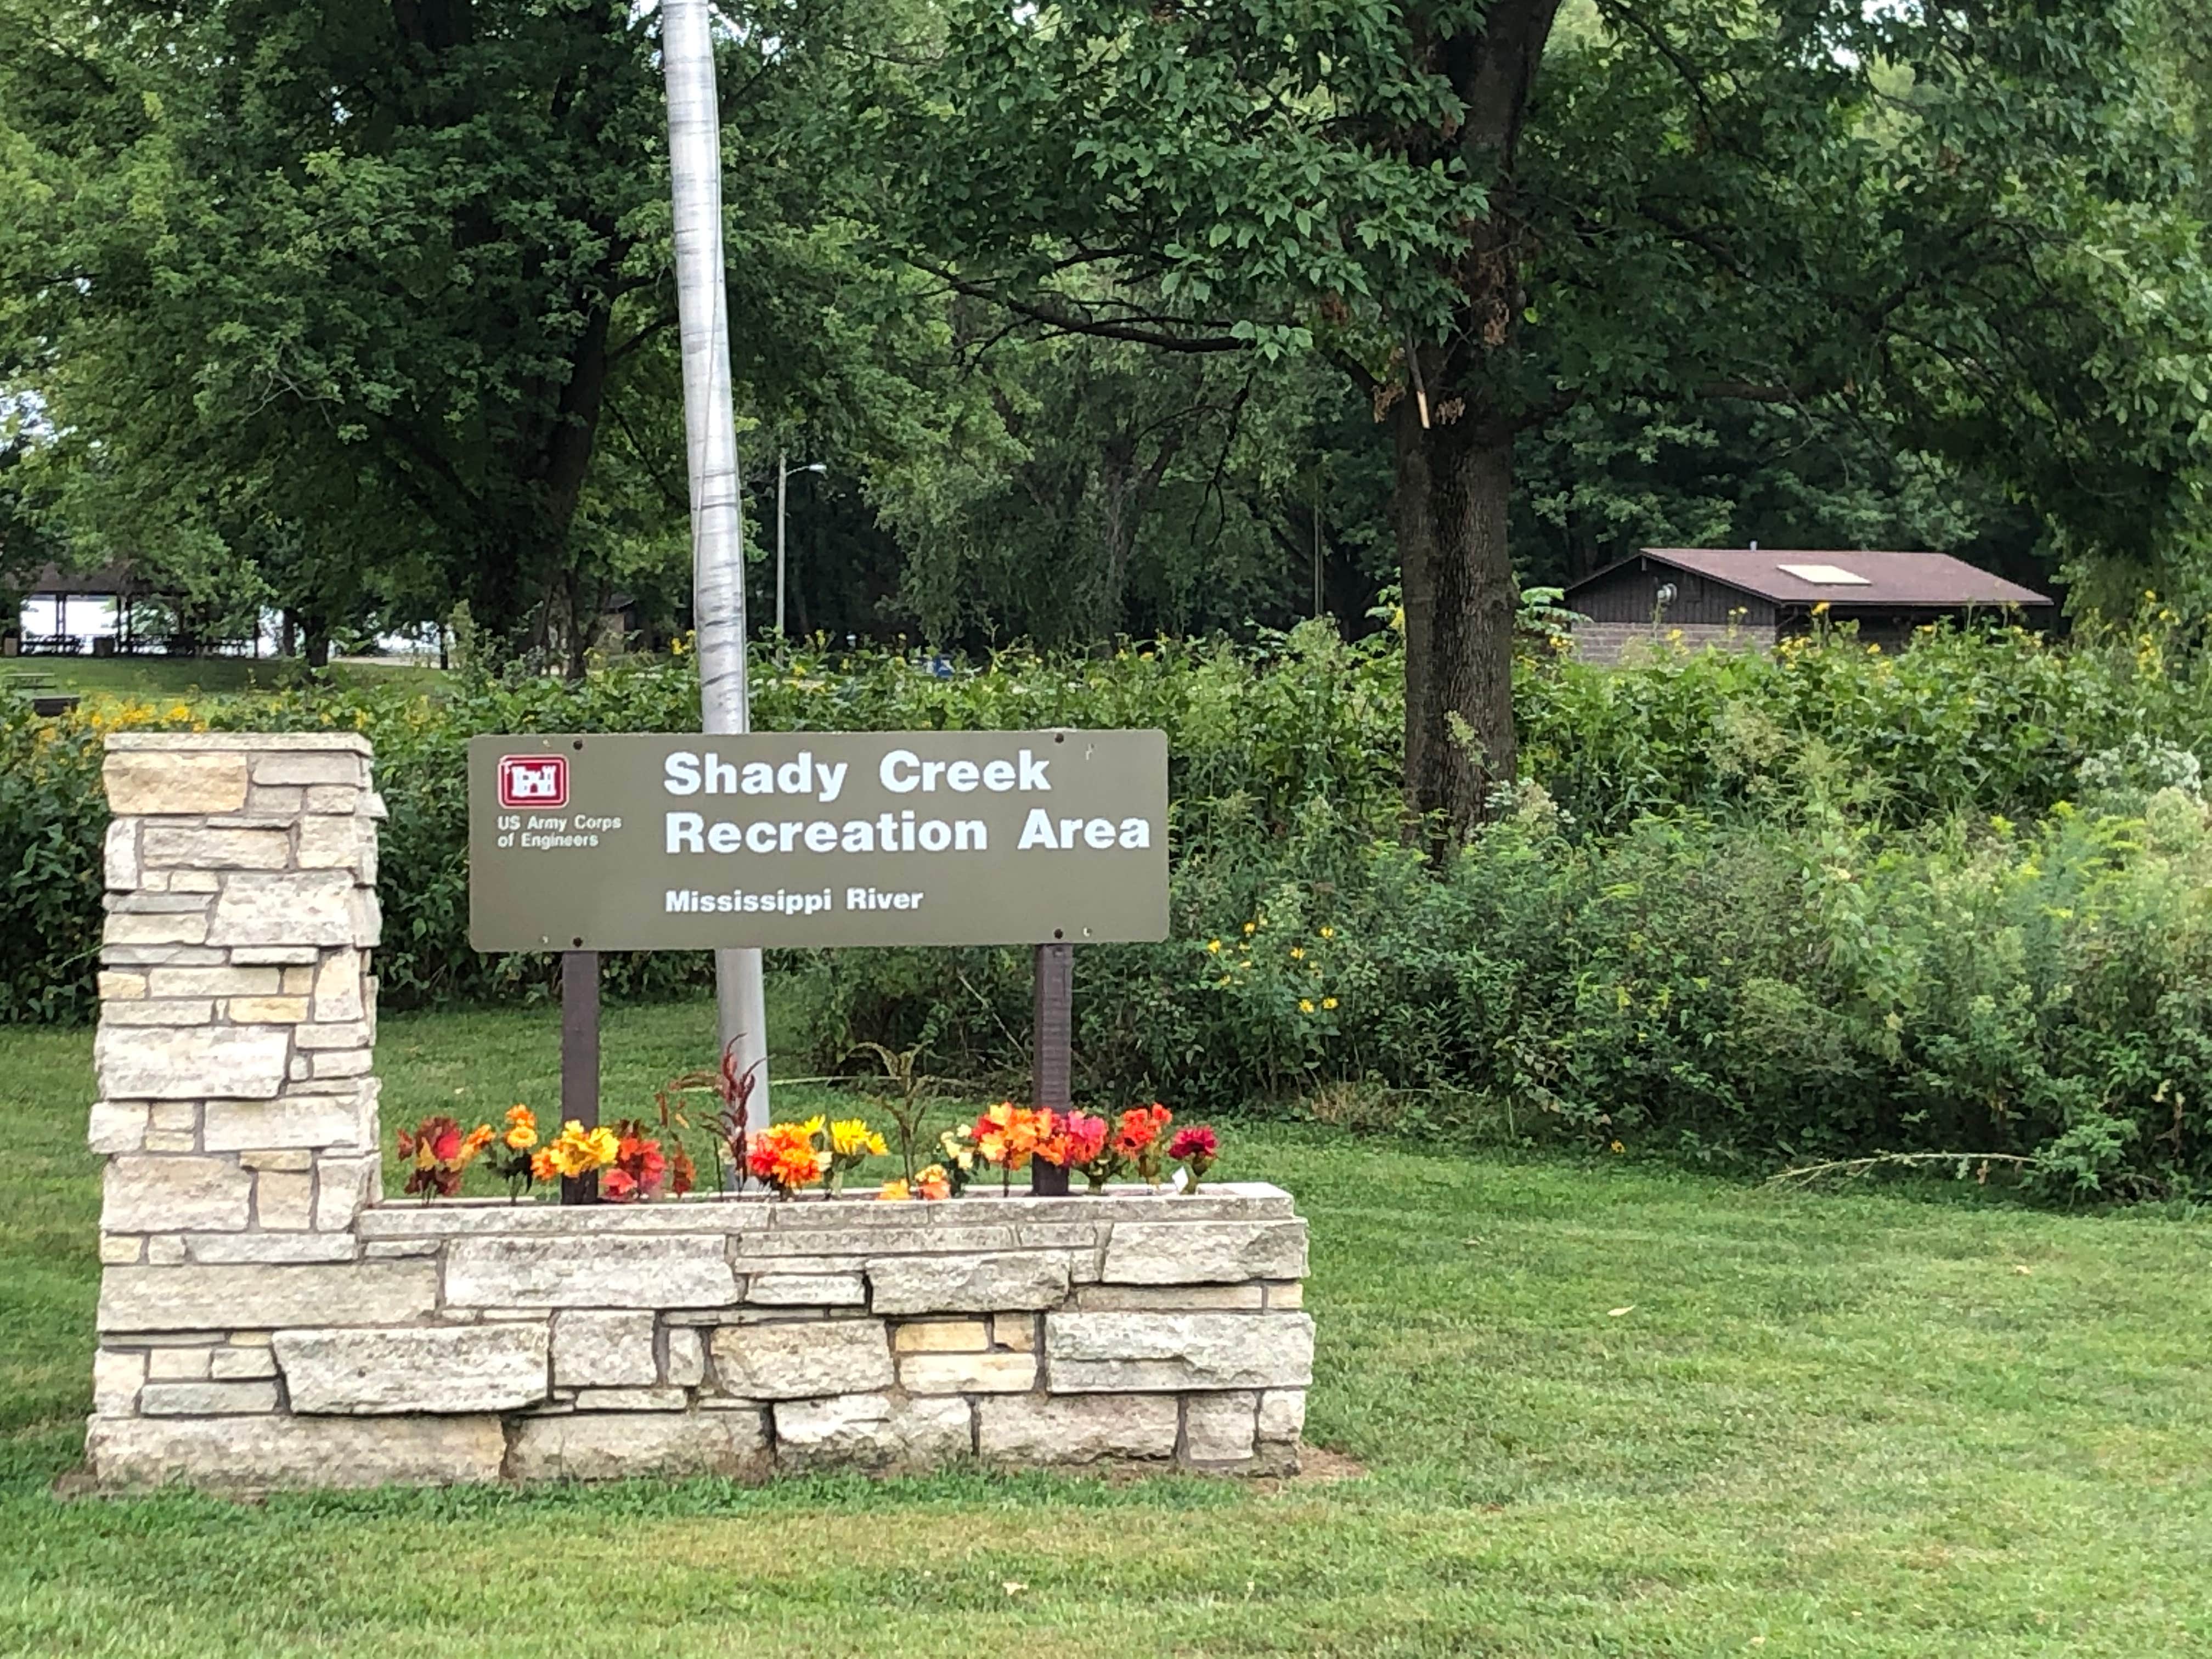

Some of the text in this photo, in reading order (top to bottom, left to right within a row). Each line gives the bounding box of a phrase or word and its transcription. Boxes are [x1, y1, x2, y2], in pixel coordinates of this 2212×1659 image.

[664, 749, 1052, 802] Shady Creek
[497, 814, 622, 832] US Army Corps
[665, 808, 1150, 854] Recreation Area
[497, 832, 599, 850] of Engineers
[665, 887, 924, 915] Mississippi River
